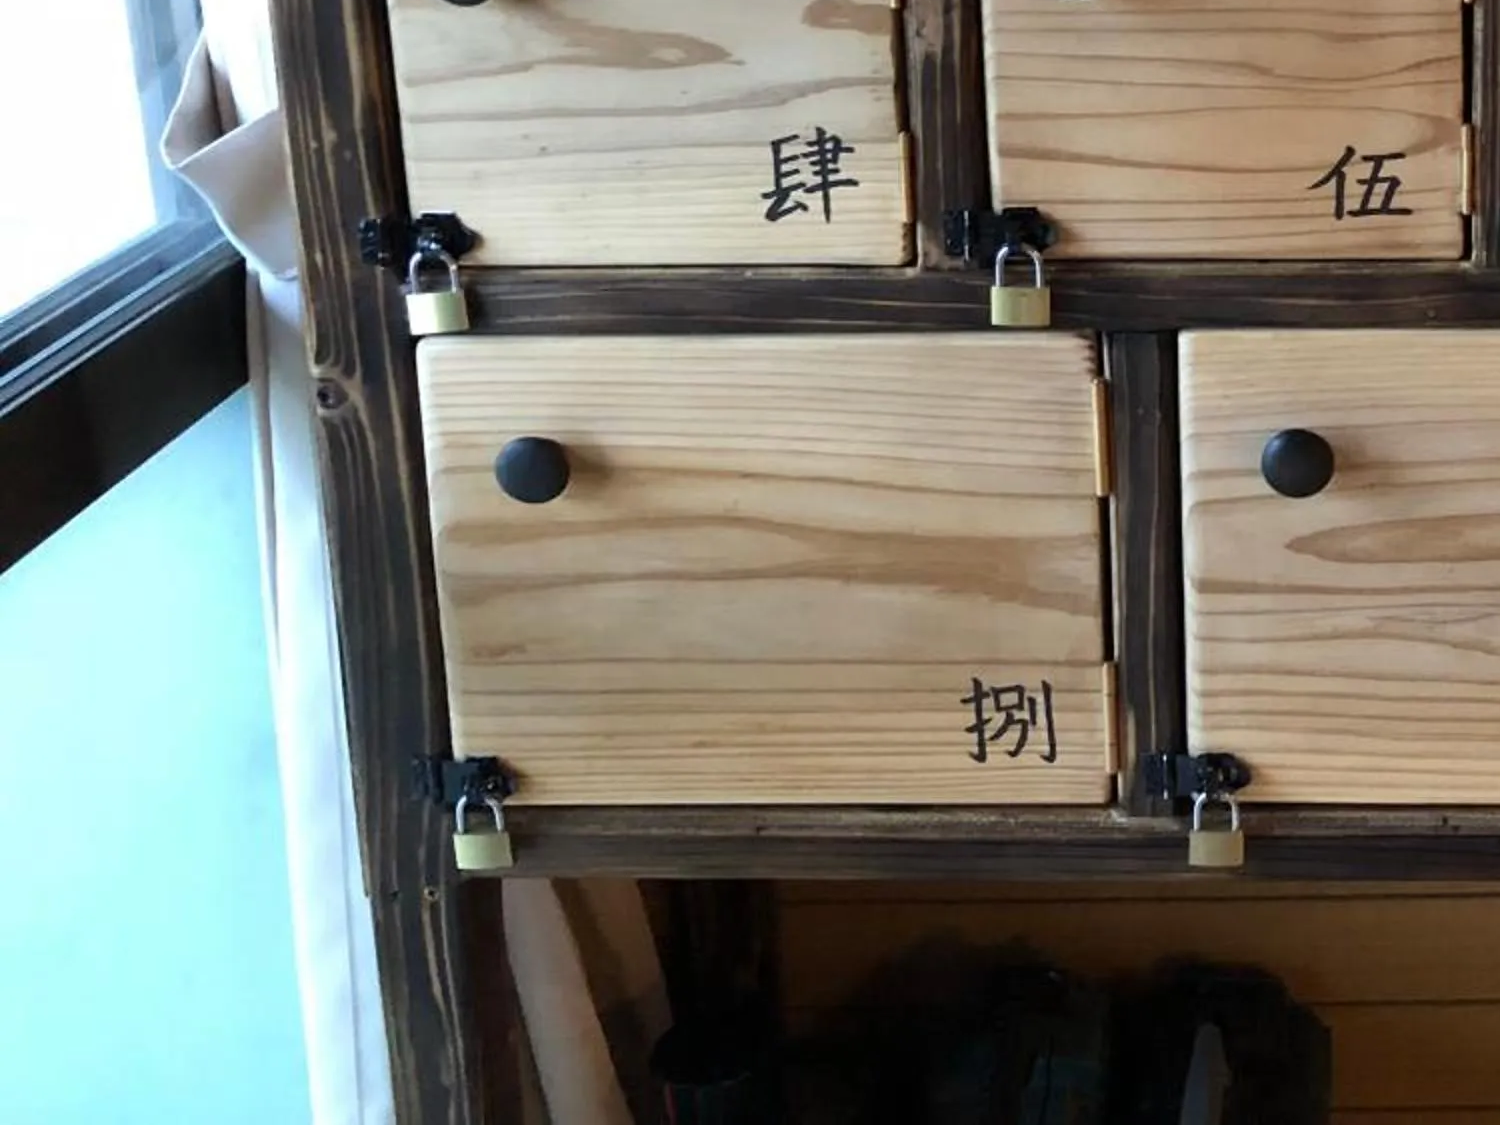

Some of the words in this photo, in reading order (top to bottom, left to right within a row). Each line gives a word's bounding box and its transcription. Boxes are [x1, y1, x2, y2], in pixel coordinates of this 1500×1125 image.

[761, 127, 859, 223] 肆
[1307, 146, 1414, 221] 伍
[960, 677, 1057, 764] 捌
